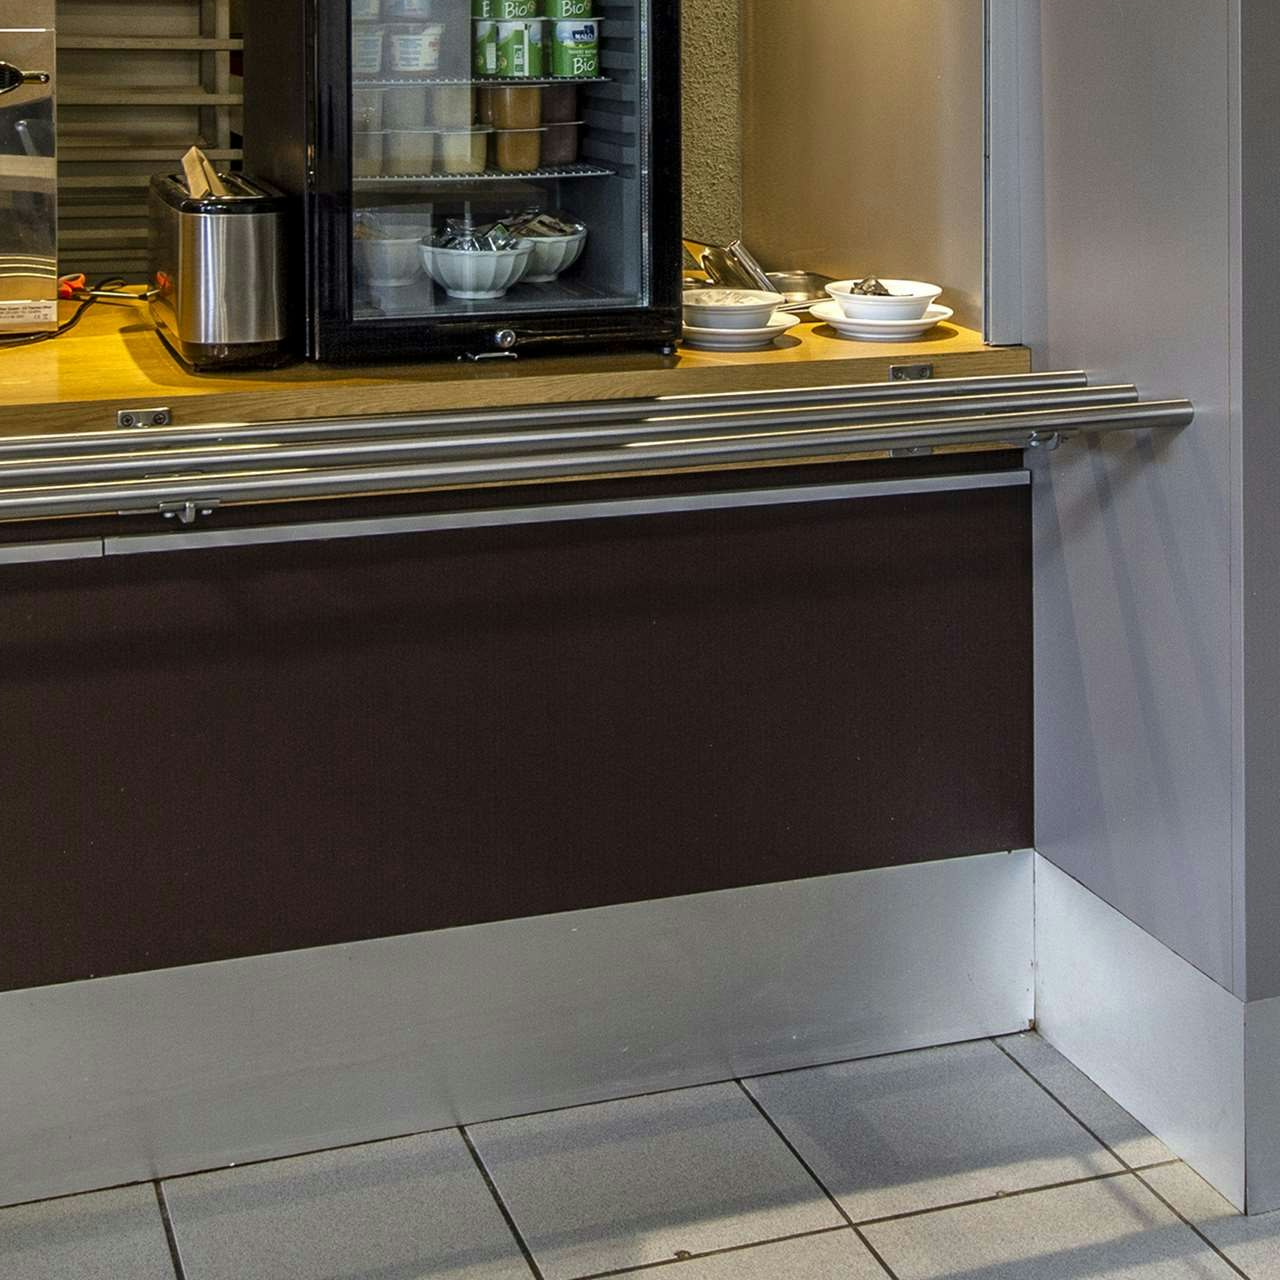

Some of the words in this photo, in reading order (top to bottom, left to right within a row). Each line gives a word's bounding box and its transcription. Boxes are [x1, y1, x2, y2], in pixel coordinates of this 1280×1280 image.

[504, 1, 528, 19] Bio
[562, 0, 584, 17] Bio
[572, 57, 596, 75] Bio
